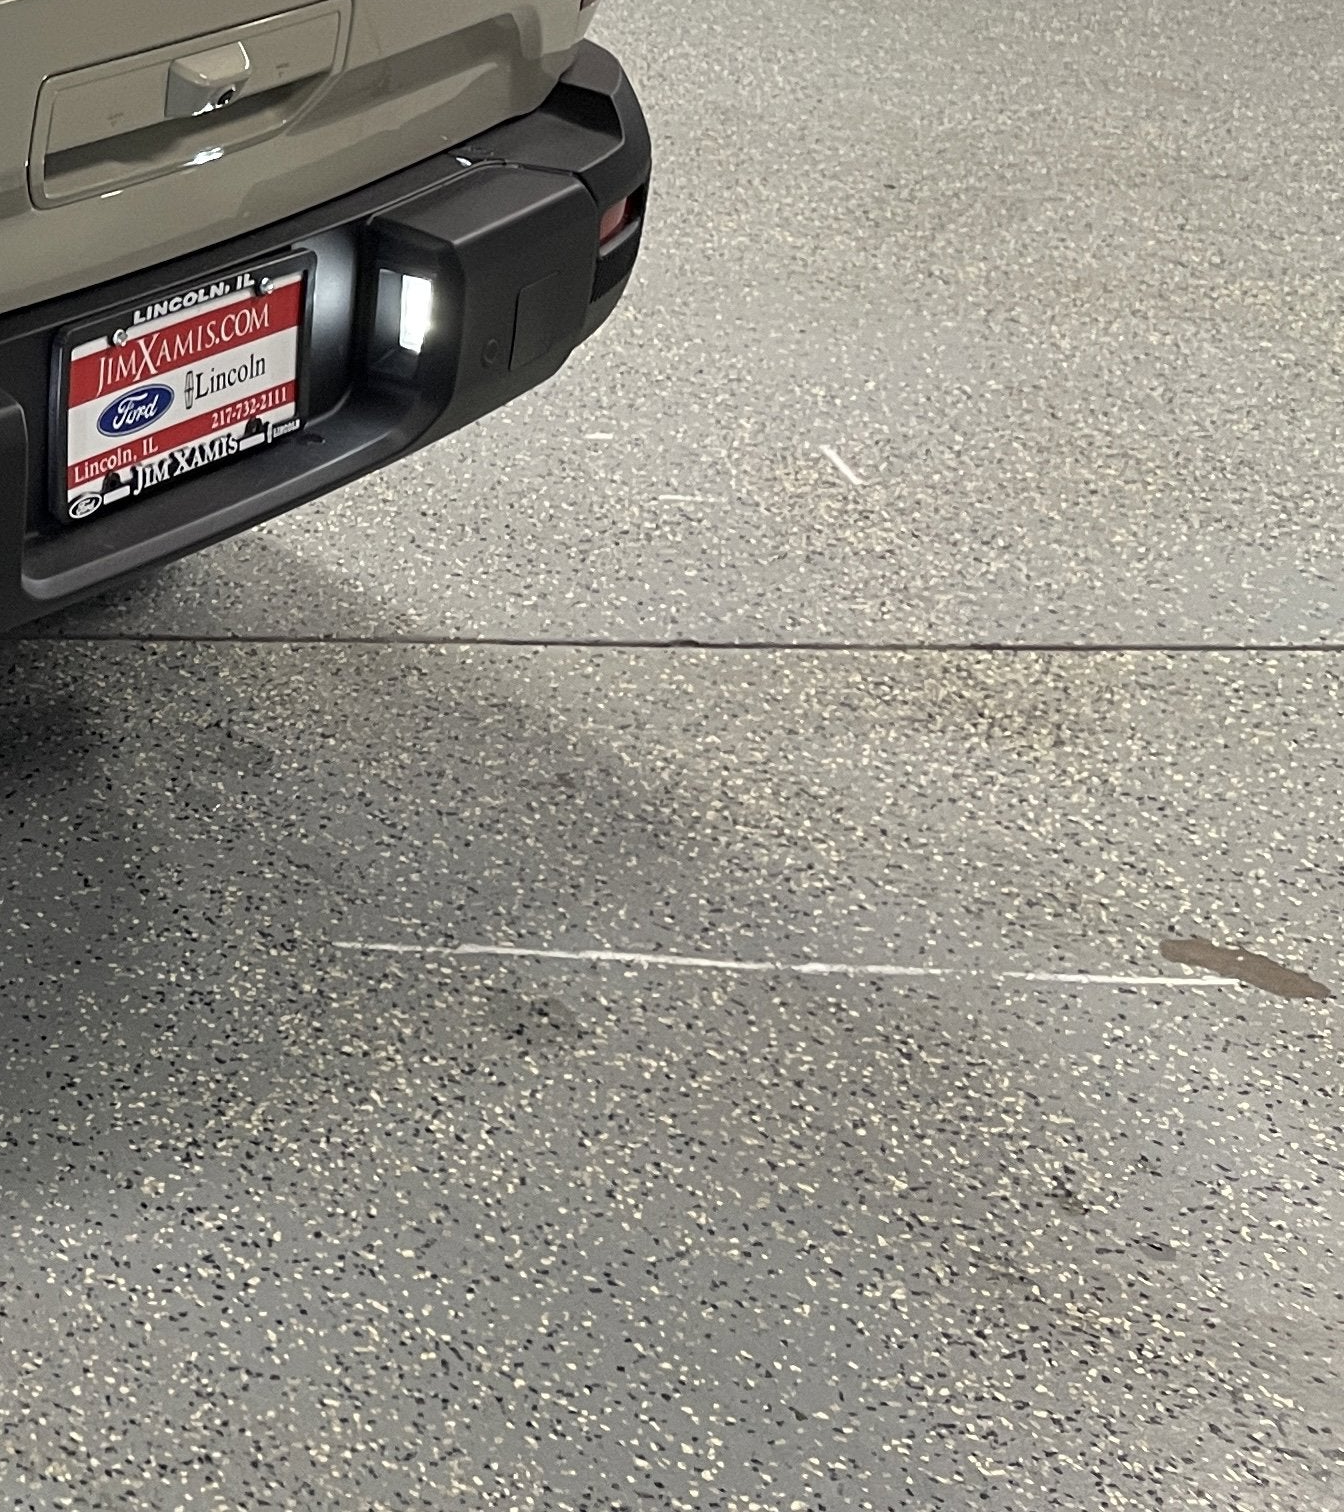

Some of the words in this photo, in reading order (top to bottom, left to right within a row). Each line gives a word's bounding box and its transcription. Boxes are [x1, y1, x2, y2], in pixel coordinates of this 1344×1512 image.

[133, 281, 231, 325] LINCOLN,
[236, 273, 255, 292] IL
[96, 303, 270, 398] JIMXAMIS.COM
[194, 354, 267, 400] Lincoln
[112, 392, 158, 430] Ford
[211, 386, 287, 429] 217-732-2111
[133, 461, 171, 496] JIM
[173, 436, 239, 477] XAMIS
[142, 437, 159, 456] IL
